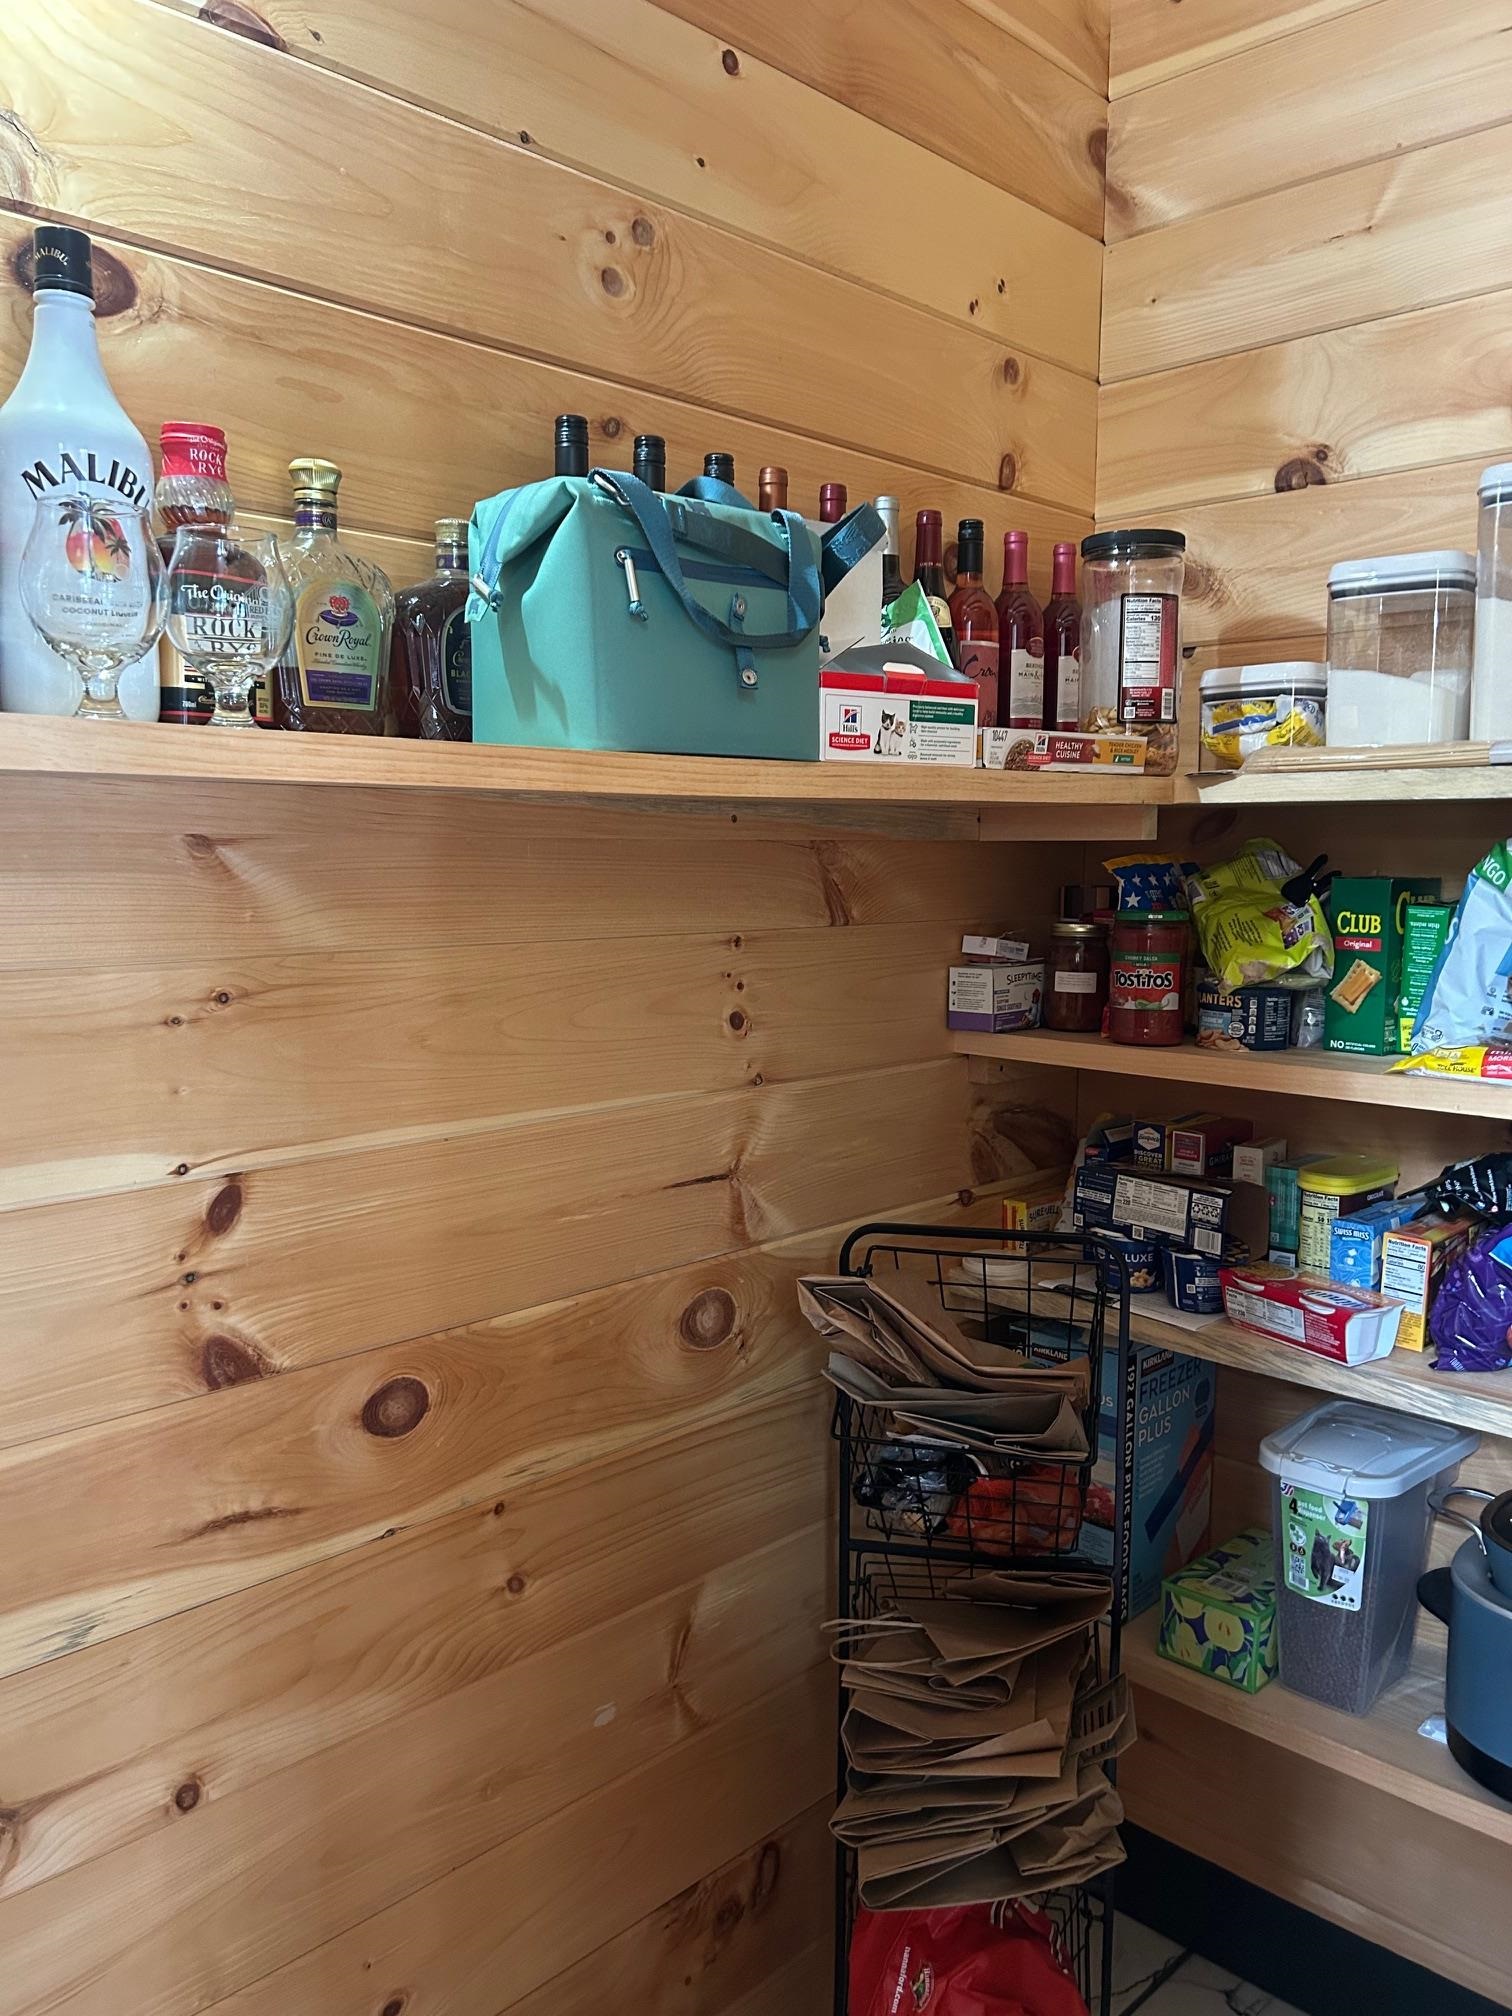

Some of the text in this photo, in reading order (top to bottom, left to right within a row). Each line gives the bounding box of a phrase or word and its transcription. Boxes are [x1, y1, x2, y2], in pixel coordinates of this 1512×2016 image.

[189, 448, 223, 466] ROCK
[181, 584, 208, 599] The
[62, 606, 109, 617] COCONUT
[193, 616, 256, 639] ROCK
[305, 625, 339, 646] Crown
[450, 669, 472, 678] BLAC
[831, 736, 869, 745] SCIENCE DIET
[1055, 741, 1084, 750] HEALTHY
[1055, 750, 1081, 759] CUISINE
[1336, 910, 1382, 934] CLUB
[1343, 940, 1373, 949] Original
[1113, 969, 1174, 989] TOSTITOS
[1330, 1039, 1345, 1049] NO
[1452, 1064, 1476, 1073] HOUSE
[1388, 1238, 1427, 1251] Nutrition Facts
[1126, 1364, 1137, 1393] 192
[1139, 1358, 1203, 1403] FREEZER
[1138, 1385, 1192, 1425] GALLON
[1123, 1398, 1136, 1468] GALLON
[1137, 1416, 1173, 1448] PLUS
[1308, 1503, 1323, 1513] food
[890, 1945, 912, 2015] hannaford.com
